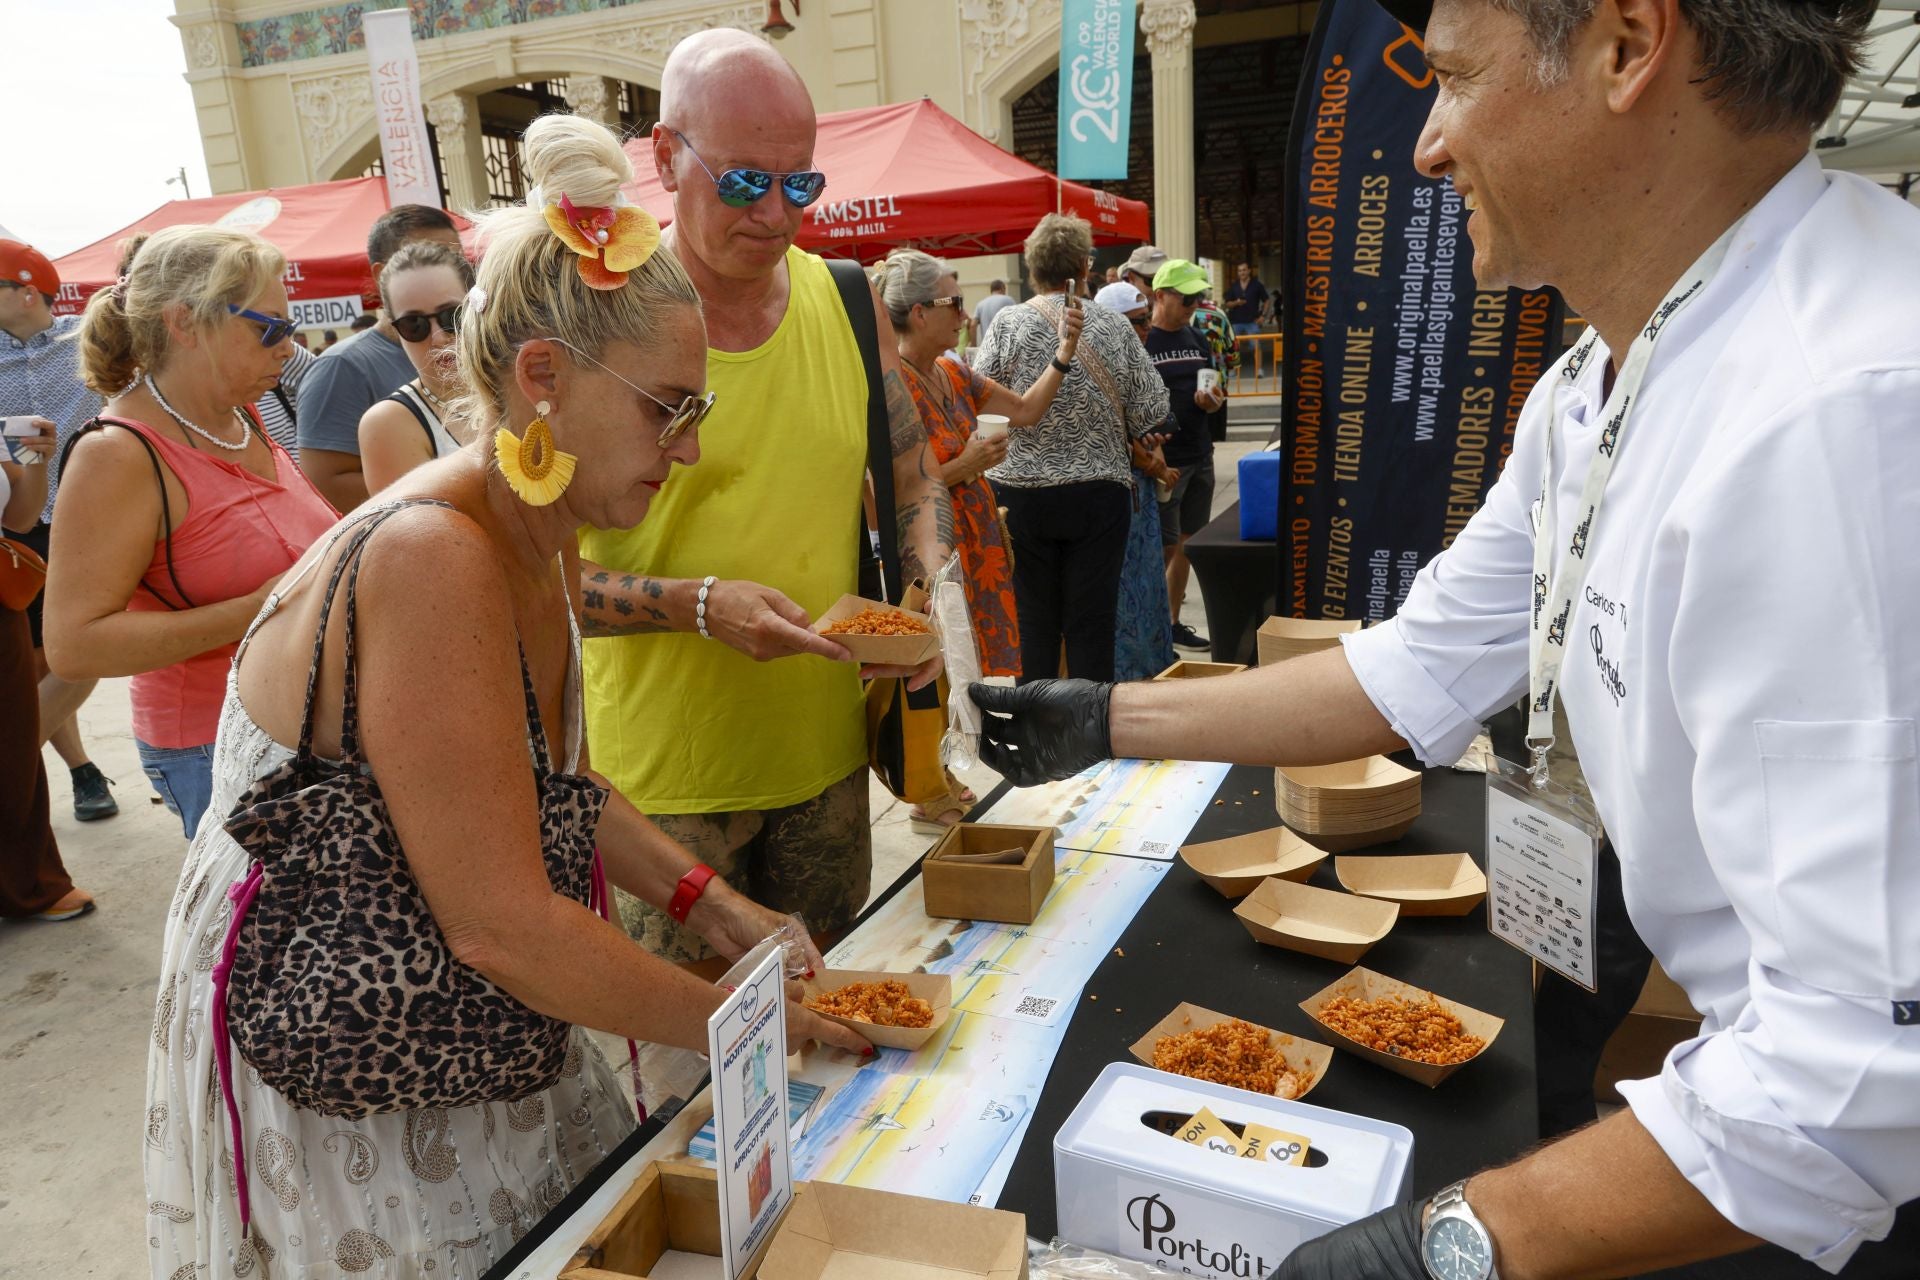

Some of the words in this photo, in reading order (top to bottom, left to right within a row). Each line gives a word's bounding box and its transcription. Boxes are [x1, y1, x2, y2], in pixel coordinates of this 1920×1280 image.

[1106, 11, 1121, 70] WORLD
[377, 61, 417, 189] VALENCIA
[1308, 66, 1351, 209] ARROCEROS
[813, 194, 902, 225] AMSTEL
[830, 226, 854, 238] 100%
[856, 222, 886, 235] MALTA
[1354, 174, 1390, 278] ARROCES
[293, 300, 358, 325] BEBIDA
[1303, 215, 1336, 338] MAESTROS
[1391, 187, 1433, 402] www.originalpaella.es
[1151, 350, 1200, 363] HILFIGER
[1340, 326, 1375, 403] ONLINE
[1504, 293, 1550, 435] DEPORTIVOS
[1292, 360, 1324, 485] FORMACIÓN
[1334, 410, 1366, 482] TIENDA
[1325, 515, 1354, 602] EVENTOS
[1585, 585, 1616, 616] Carlos
[723, 1037, 748, 1072] MOJITO
[748, 1002, 778, 1042] COCONUT
[733, 1133, 760, 1173] APRICOT
[759, 1107, 779, 1139] SPRITZ
[1126, 1193, 1272, 1278] Portolit
